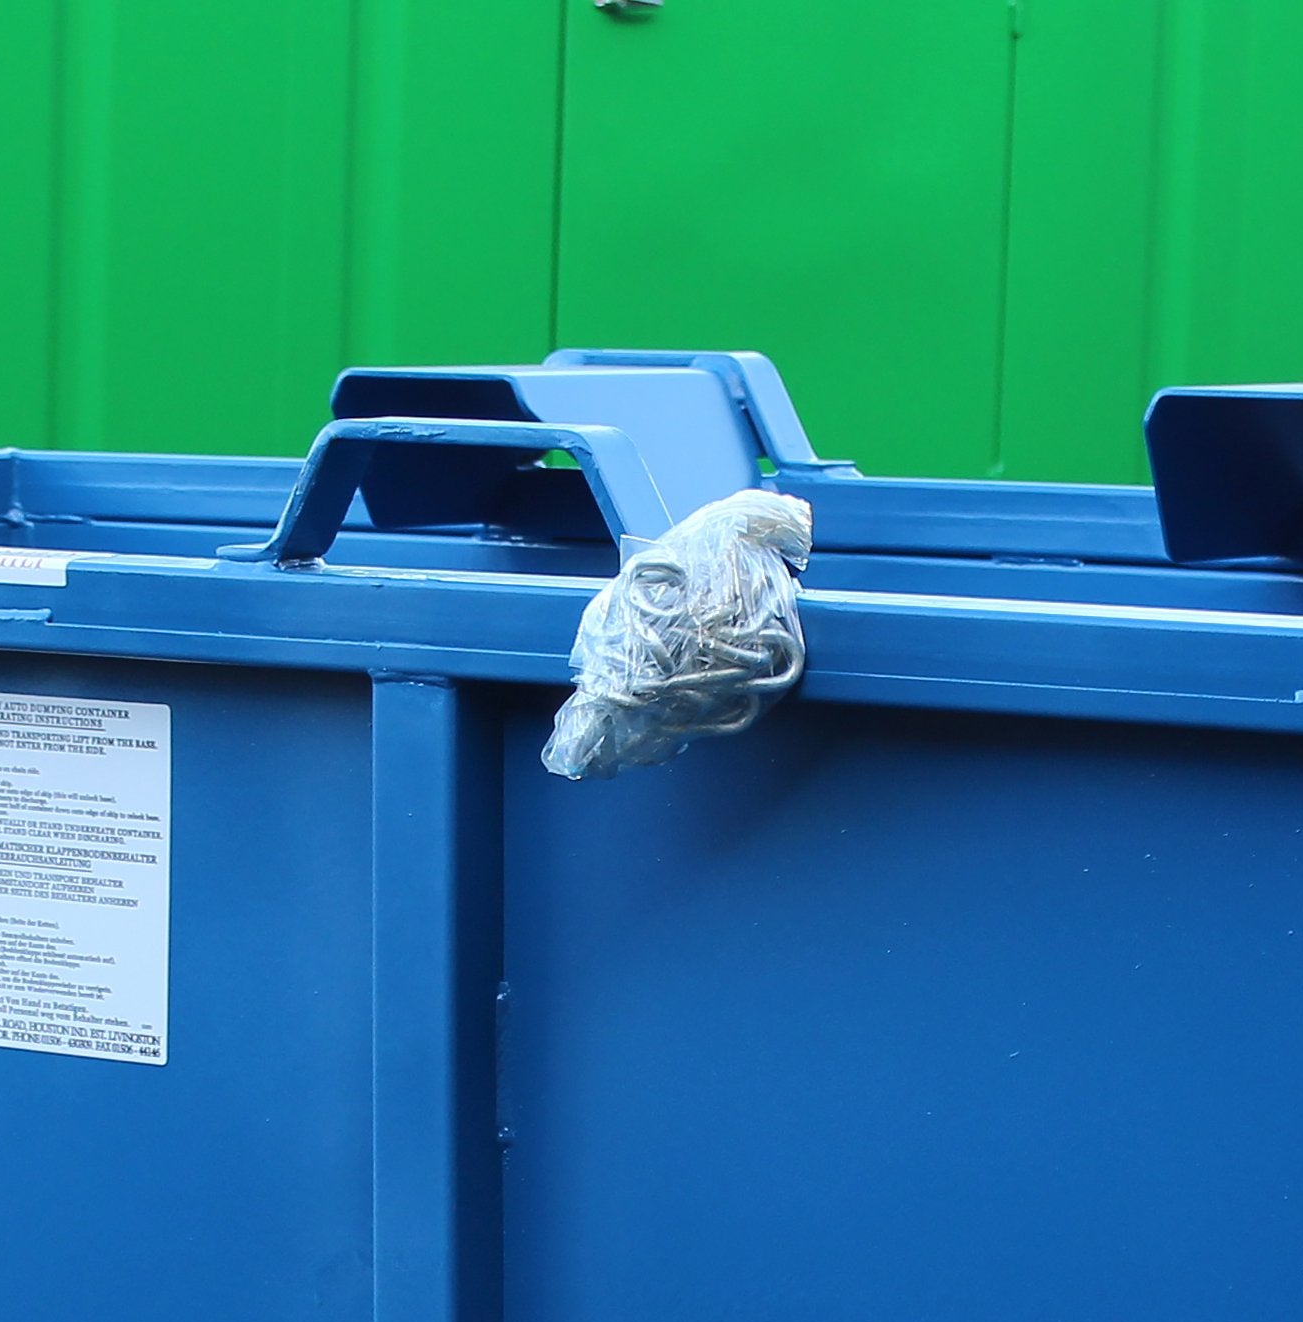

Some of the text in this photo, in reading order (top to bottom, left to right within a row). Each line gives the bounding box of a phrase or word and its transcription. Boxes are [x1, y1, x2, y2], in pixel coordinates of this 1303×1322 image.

[4, 701, 27, 711] AUTO
[30, 703, 72, 715] DUMPING
[75, 706, 129, 719] CONTAINER
[34, 714, 102, 728] INSTRUCTIONS
